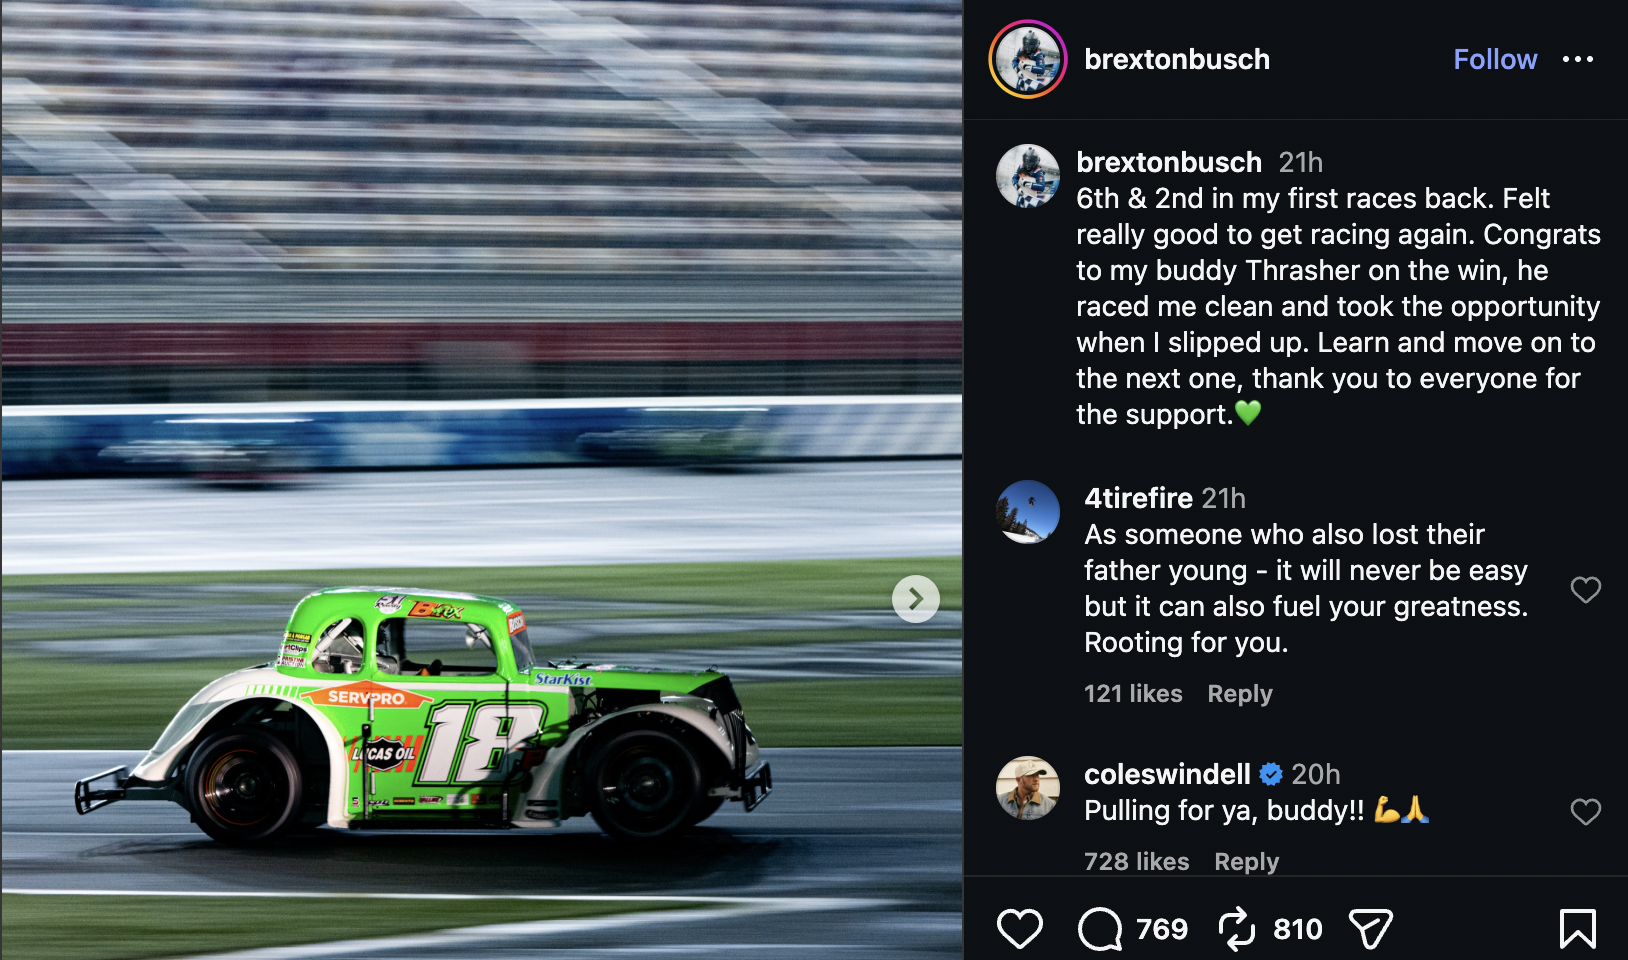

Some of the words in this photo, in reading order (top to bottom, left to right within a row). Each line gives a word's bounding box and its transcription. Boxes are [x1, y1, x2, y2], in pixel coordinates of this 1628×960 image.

[1085, 47, 1270, 71] brextonbusch
[1454, 47, 1539, 71] Follow
[1077, 150, 1262, 174] brextonbusch
[1279, 150, 1323, 173] 21h
[1076, 186, 1119, 210] 6th
[1127, 186, 1148, 210] &
[1155, 186, 1203, 210] 2nd
[1212, 186, 1234, 209] in
[1242, 191, 1281, 214] my
[1287, 186, 1339, 210] first
[1346, 191, 1417, 210] races
[1425, 186, 1494, 210] back.
[1503, 186, 1551, 210] Felt
[1077, 222, 1146, 250] really
[1153, 222, 1218, 250] good
[1226, 224, 1253, 246] to
[1260, 224, 1303, 251] get
[1311, 222, 1390, 251] racing
[1398, 222, 1475, 251] again.
[1483, 222, 1602, 251] Congrats
[1075, 260, 1102, 282] to
[1110, 263, 1149, 286] my
[1156, 258, 1238, 286] buddy
[1245, 258, 1361, 282] Thrasher
[1368, 263, 1400, 282] on
[1407, 258, 1450, 282] the
[1457, 258, 1508, 286] win,
[1518, 258, 1549, 282] he
[1077, 294, 1149, 318] raced
[1158, 299, 1197, 318] me
[1204, 294, 1273, 318] clean
[1281, 294, 1329, 318] and
[1336, 294, 1395, 318] took
[1401, 294, 1443, 318] the
[1450, 294, 1601, 322] opportunity
[1076, 330, 1145, 354] when
[1154, 331, 1159, 353] I
[1168, 330, 1261, 358] slipped
[1270, 335, 1309, 358] up.
[1318, 331, 1390, 354] Learn
[1397, 330, 1445, 354] and
[1454, 335, 1523, 354] move
[1530, 335, 1562, 354] on
[1570, 332, 1596, 354] to
[1075, 366, 1118, 390] the
[1126, 368, 1181, 390] next
[1188, 371, 1243, 394] one,
[1251, 366, 1325, 390] thank
[1331, 371, 1378, 394] you
[1385, 368, 1412, 390] to
[1419, 371, 1538, 394] everyone
[1544, 366, 1582, 390] for
[1075, 402, 1118, 426] the
[1125, 404, 1233, 430] support.
[1084, 485, 1194, 510] 4tirefire
[1201, 486, 1246, 509] 21h
[1084, 523, 1117, 546] As
[1124, 527, 1243, 546] someone
[1250, 522, 1304, 546] who
[1311, 522, 1364, 546] also
[1372, 522, 1419, 546] lost
[1426, 521, 1486, 546] their
[1083, 558, 1162, 582] father
[1168, 563, 1247, 587] young
[1276, 558, 1293, 581] it
[1299, 558, 1341, 581] will
[1350, 563, 1422, 582] never
[1429, 558, 1461, 582] be
[1468, 563, 1529, 586] easy
[1085, 594, 1127, 618] but
[1135, 594, 1151, 617] it
[1158, 599, 1205, 618] can
[1212, 594, 1265, 618] also
[1272, 594, 1321, 618] fuel
[1328, 599, 1387, 622] your
[1393, 596, 1528, 623] greatness.
[1085, 629, 1183, 659] Rooting
[1190, 630, 1228, 654] for
[1234, 635, 1288, 658] you.
[535, 672, 593, 686] StarKist
[328, 690, 406, 705] SERVPRO
[1084, 683, 1121, 703] 121
[1130, 682, 1183, 703] likes
[1208, 683, 1274, 708] Reply
[395, 747, 416, 760] OIL
[412, 700, 548, 787] 18
[1084, 761, 1251, 786] coleswindell
[1291, 762, 1341, 786] 20h
[1085, 797, 1170, 826] Pulling
[1177, 798, 1215, 822] for
[1221, 803, 1258, 826] ya,
[1267, 798, 1364, 826] buddy!!
[1084, 851, 1129, 872] 728
[1137, 850, 1190, 871] likes
[1215, 851, 1280, 876] Reply
[1136, 917, 1189, 941] 769
[1273, 917, 1323, 941] 810
